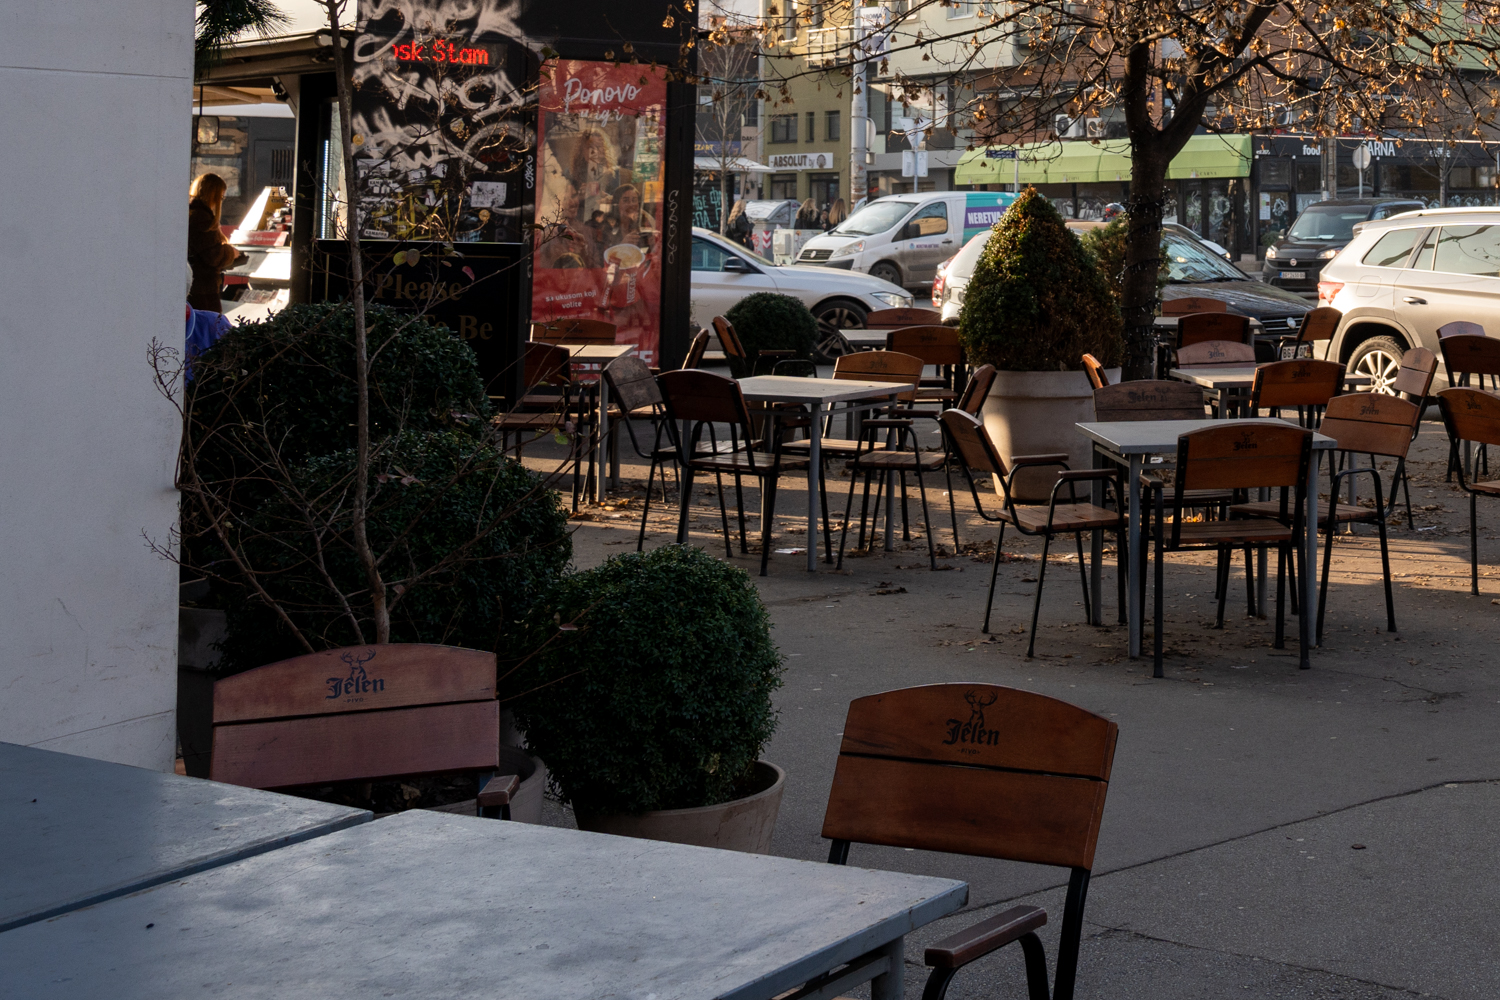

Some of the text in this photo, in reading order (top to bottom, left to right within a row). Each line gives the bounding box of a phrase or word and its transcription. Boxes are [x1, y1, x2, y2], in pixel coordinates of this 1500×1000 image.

[563, 77, 643, 114] Ponovo
[376, 273, 464, 301] Please
[555, 291, 583, 302] ukusom
[458, 314, 494, 340] Be
[325, 676, 386, 700] Jelen
[942, 718, 1000, 747] Jelen
